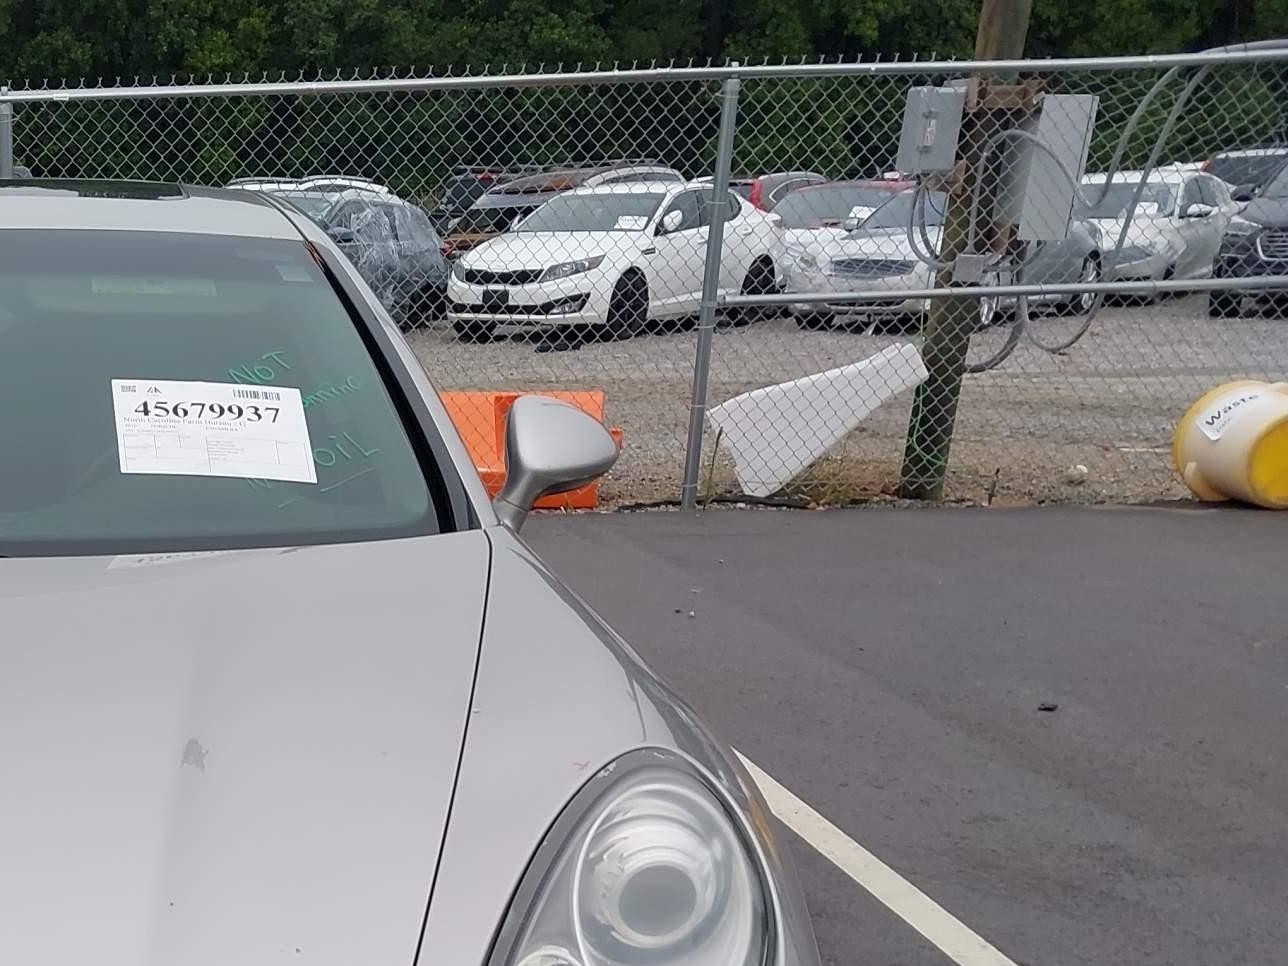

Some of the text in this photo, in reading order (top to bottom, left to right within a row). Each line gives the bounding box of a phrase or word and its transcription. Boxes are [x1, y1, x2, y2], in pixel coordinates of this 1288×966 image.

[227, 350, 291, 385] NOT
[133, 399, 281, 425] 45679937
[1204, 393, 1260, 427] Waste
